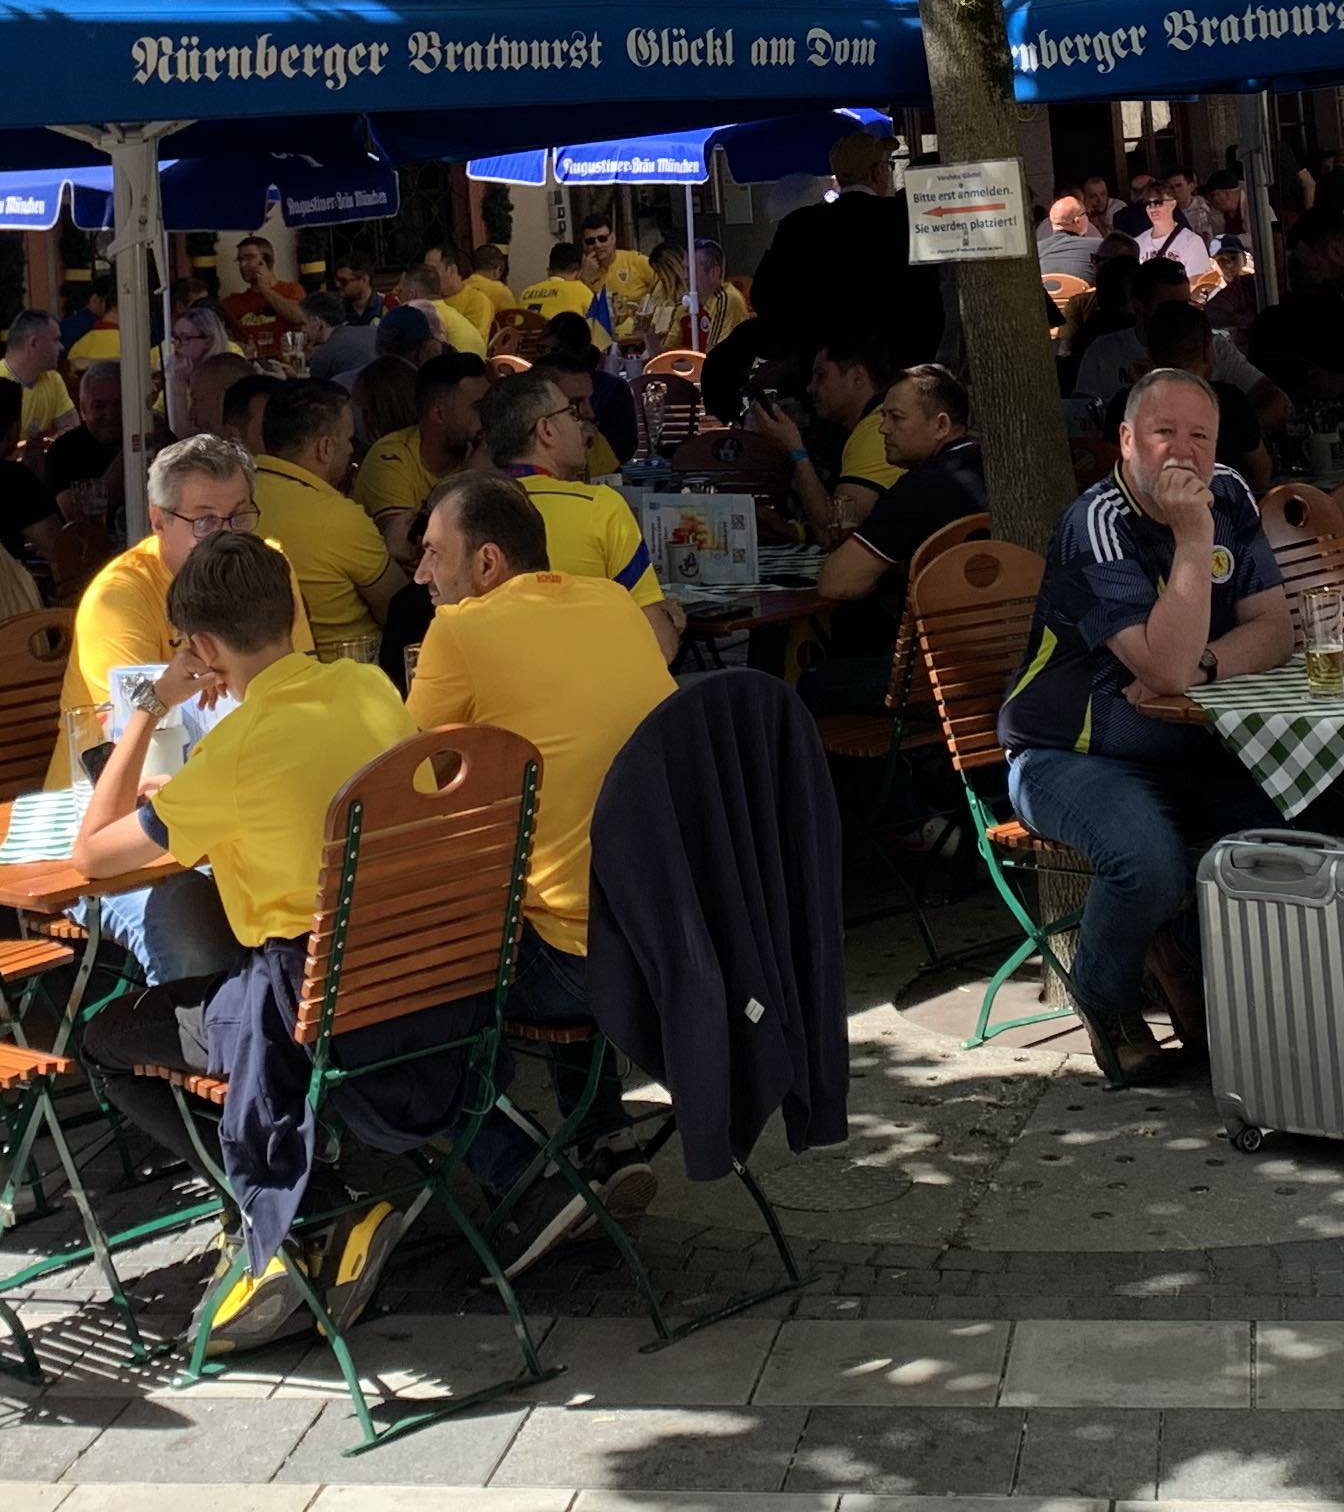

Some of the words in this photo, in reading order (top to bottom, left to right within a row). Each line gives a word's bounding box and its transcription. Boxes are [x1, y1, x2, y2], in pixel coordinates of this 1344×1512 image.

[131, 33, 390, 90] Nürnberger
[408, 30, 603, 74] Bratwurst
[626, 26, 735, 67] Glöckl
[750, 36, 796, 67] am
[806, 27, 877, 67] Dom
[1010, 24, 1148, 74] nberger
[657, 157, 700, 174] München
[913, 192, 936, 203] Bitte
[938, 191, 955, 201] erst
[957, 185, 1014, 199] anmelden.
[5, 196, 45, 215] München
[915, 223, 929, 234] Sie
[931, 220, 968, 233] werden
[970, 216, 1017, 231] platziert!
